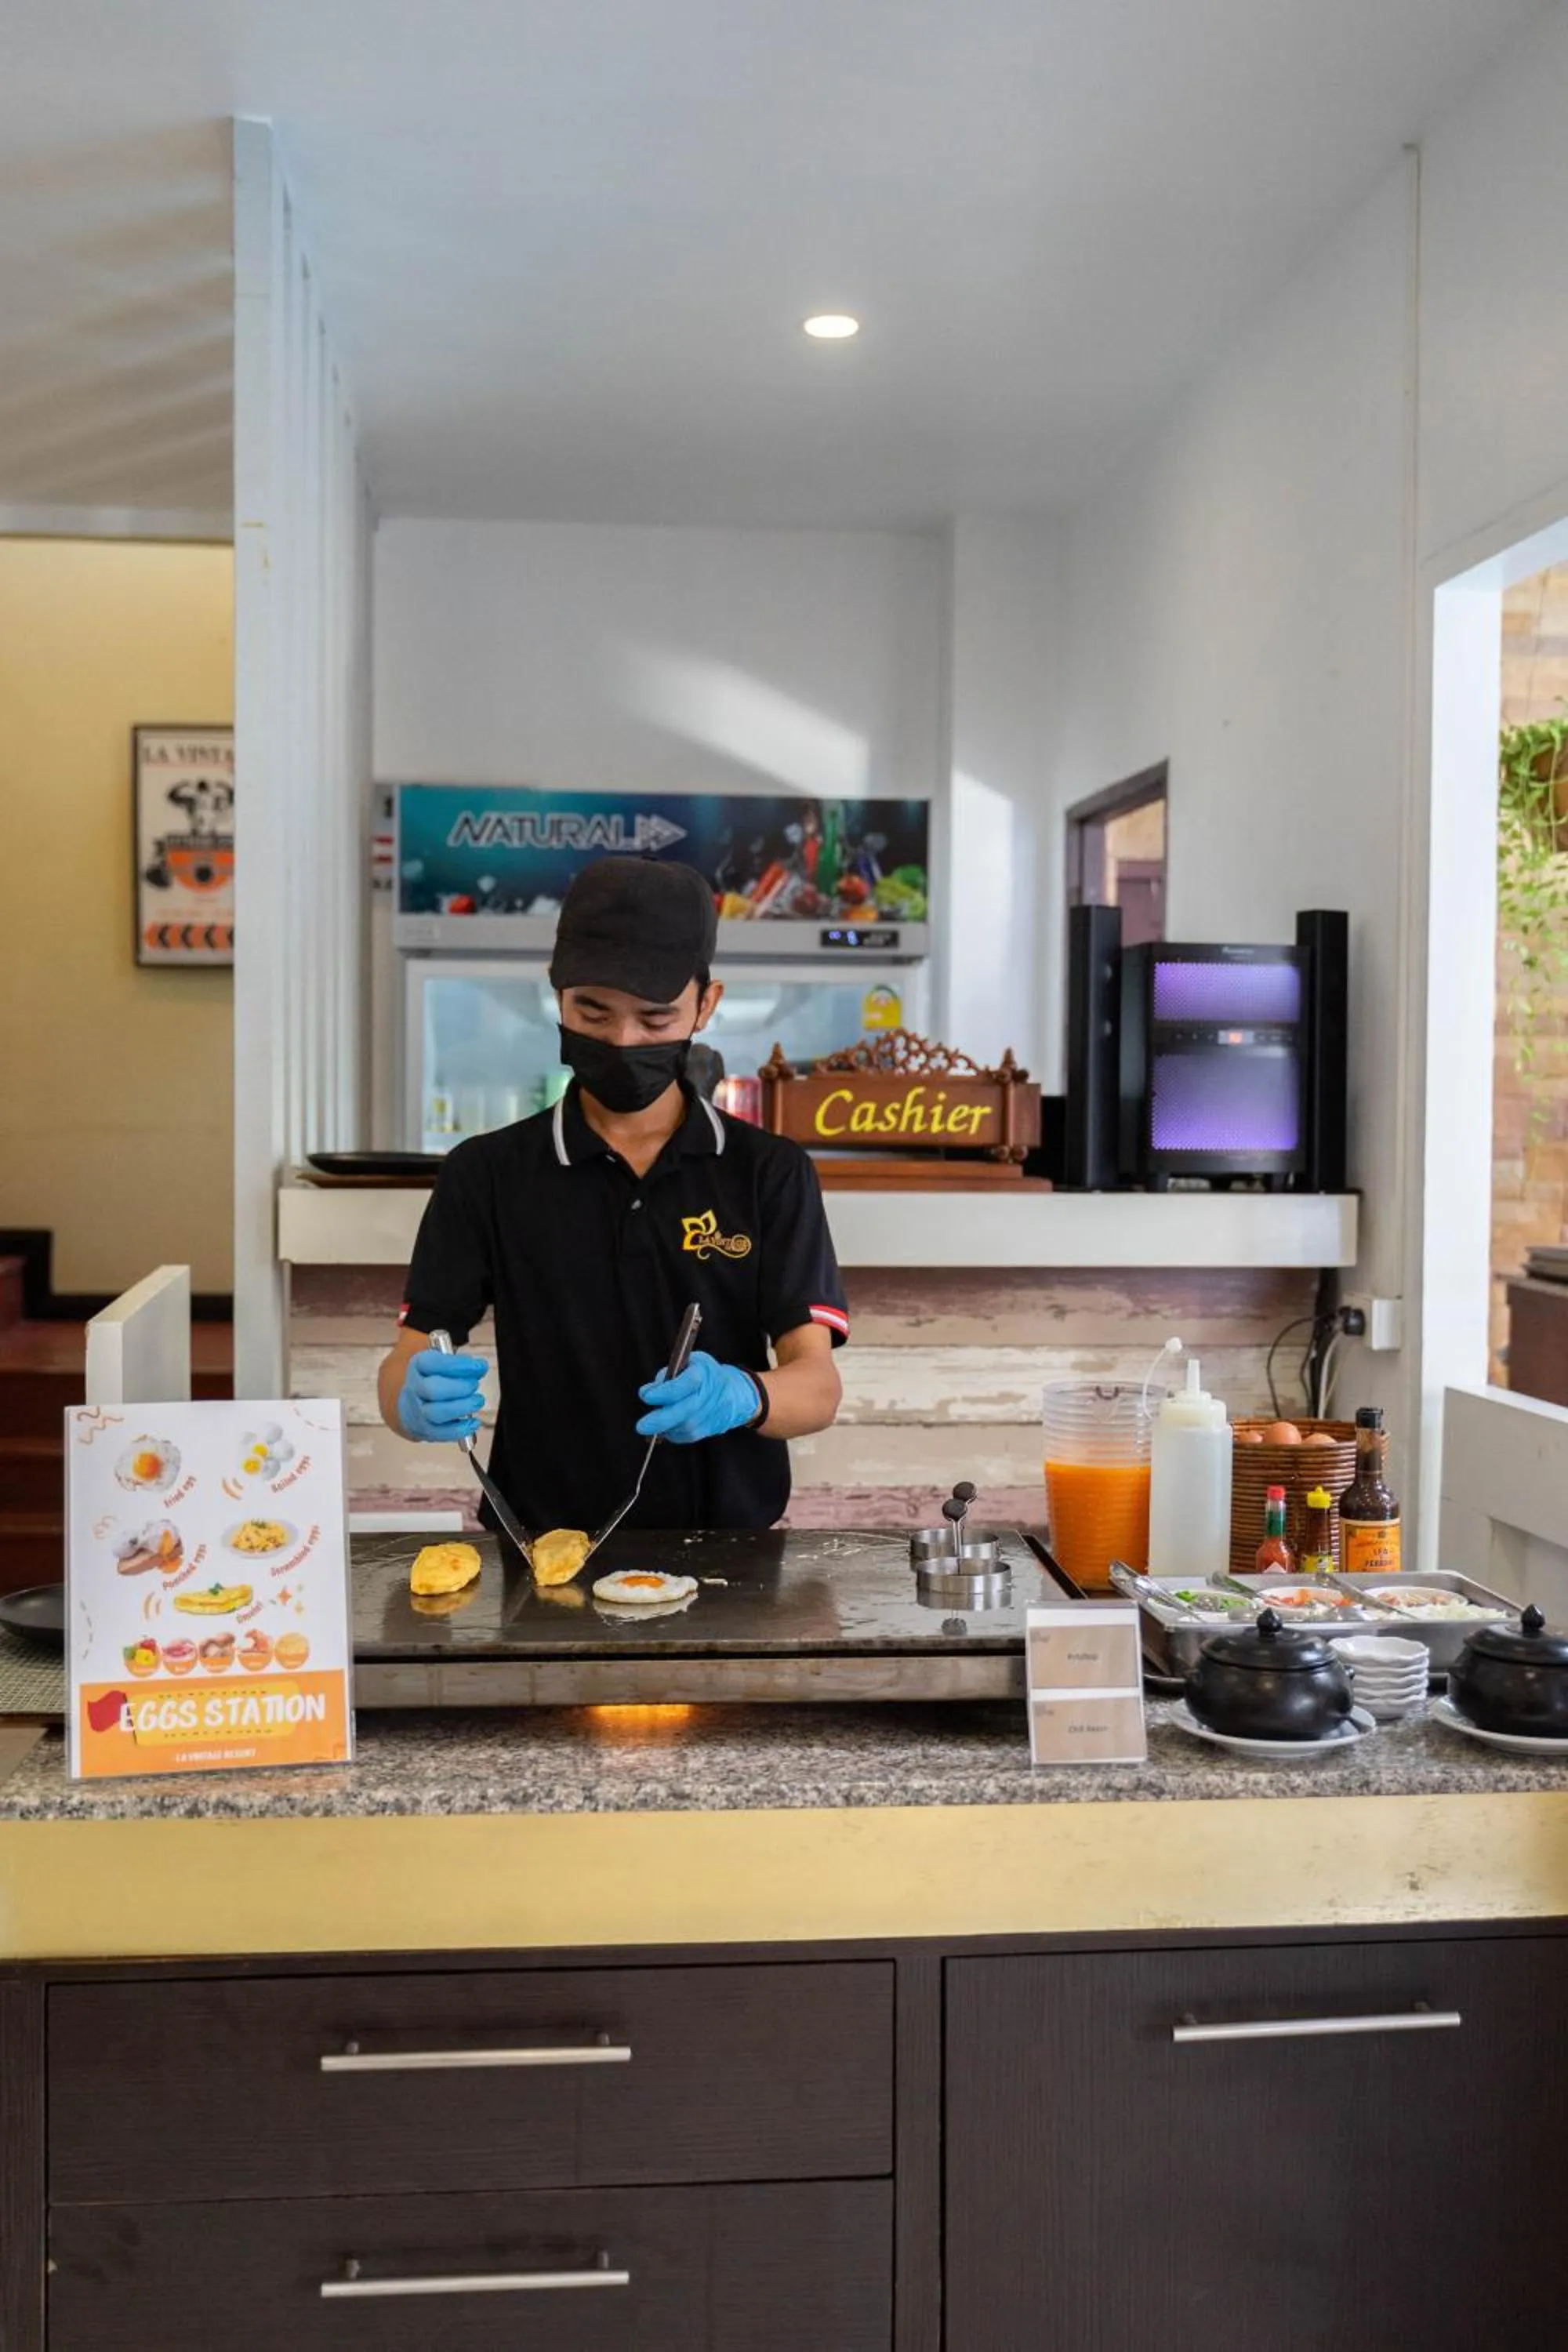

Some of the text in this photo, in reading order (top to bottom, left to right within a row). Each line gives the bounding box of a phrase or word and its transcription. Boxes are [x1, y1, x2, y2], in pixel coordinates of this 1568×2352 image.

[446, 810, 643, 851] NATURAL
[815, 1087, 993, 1137] Cashier
[120, 1693, 325, 1733] EGGS STATION
